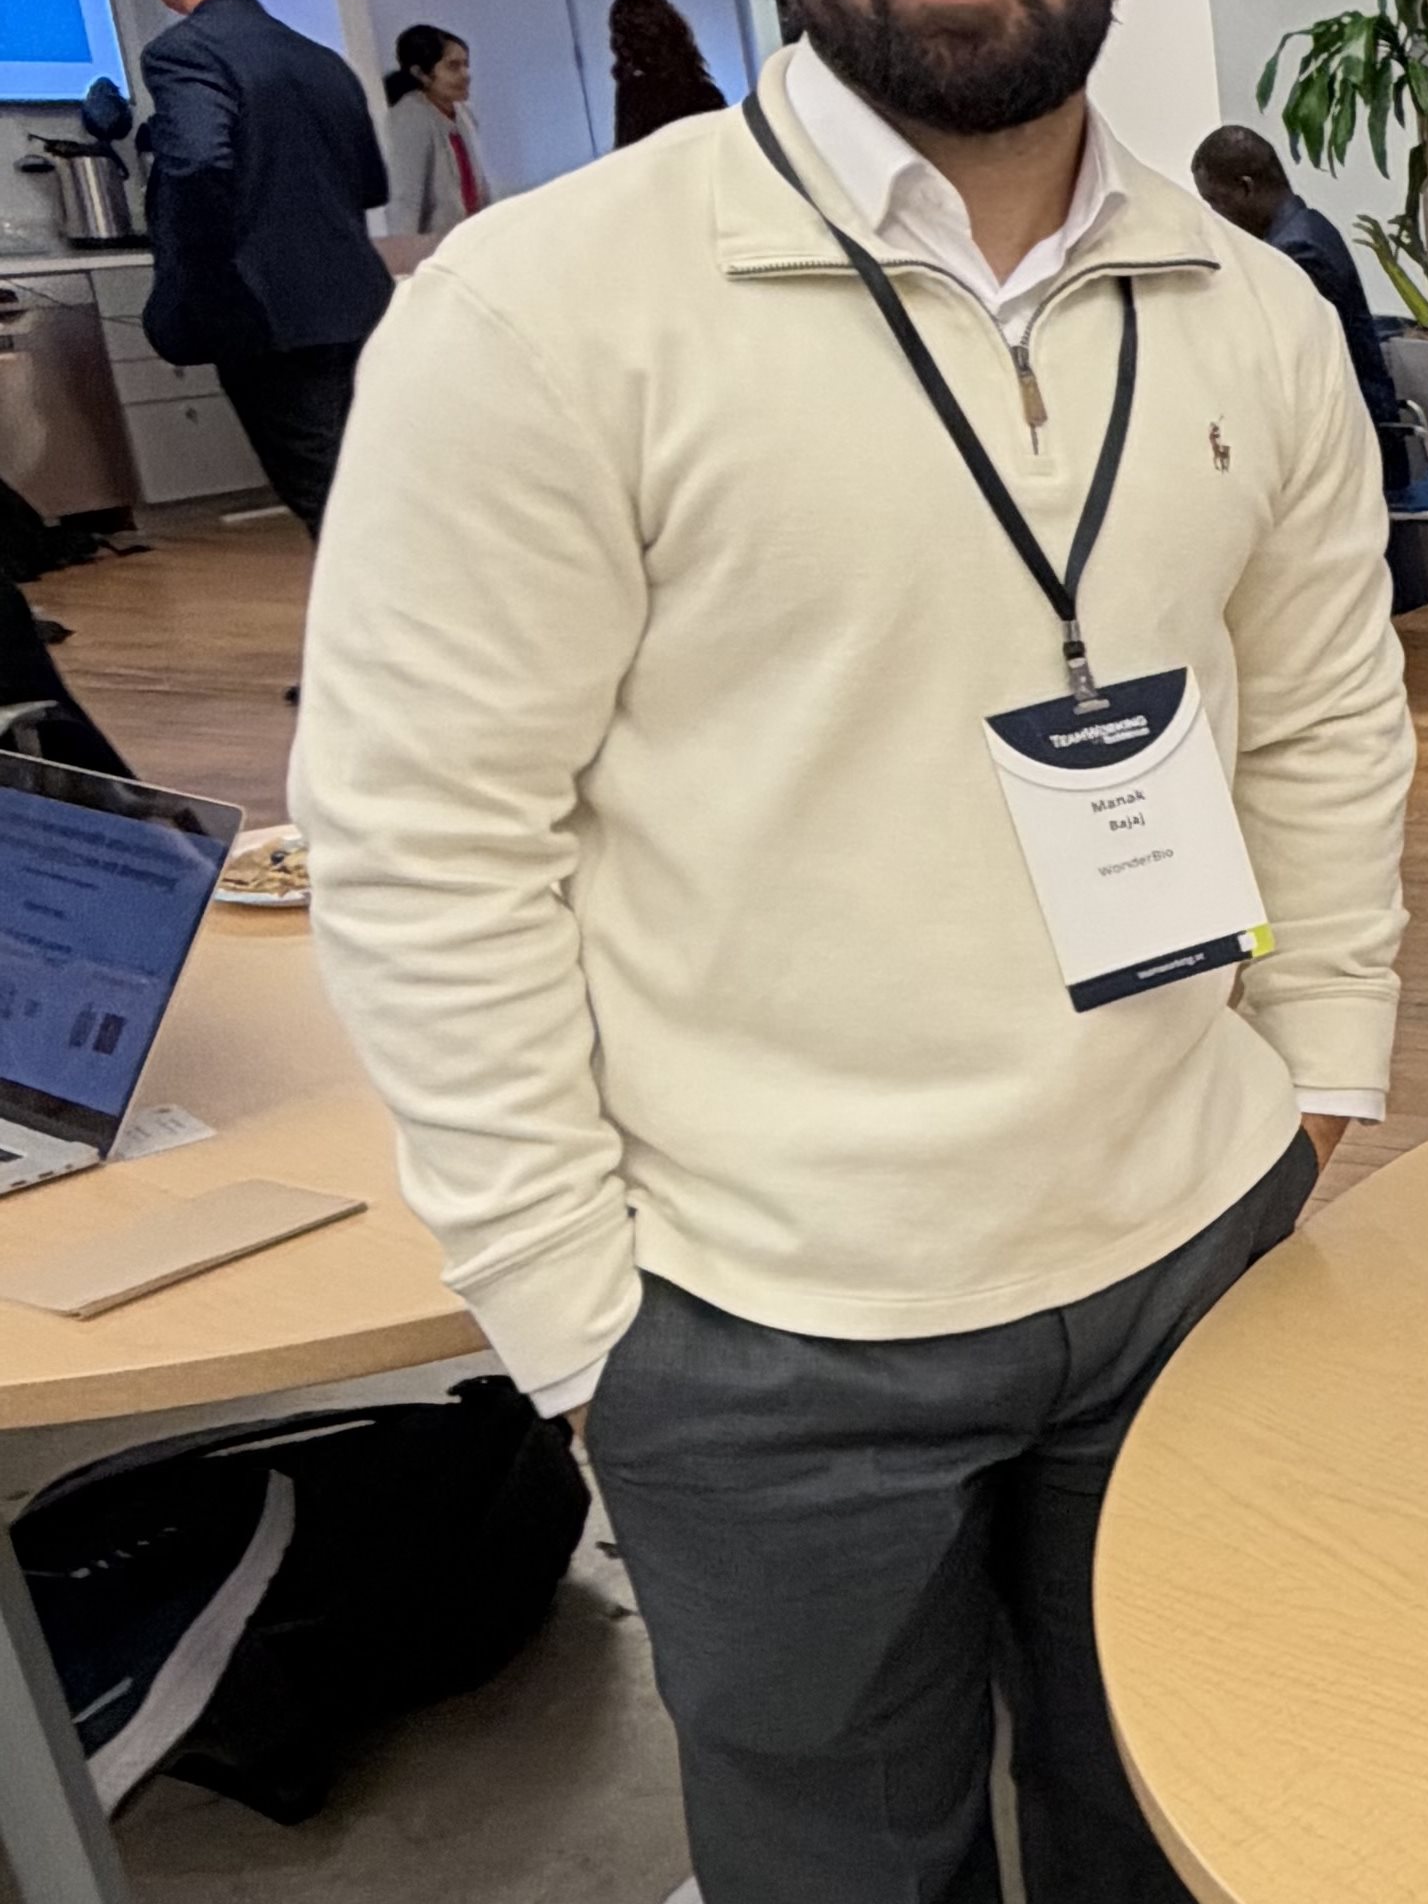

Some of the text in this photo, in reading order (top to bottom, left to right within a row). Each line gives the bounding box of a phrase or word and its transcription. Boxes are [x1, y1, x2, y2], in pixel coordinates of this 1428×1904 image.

[1091, 790, 1146, 813] Manak
[1109, 812, 1146, 832] Bajaj
[1098, 848, 1174, 877] WonderBio
